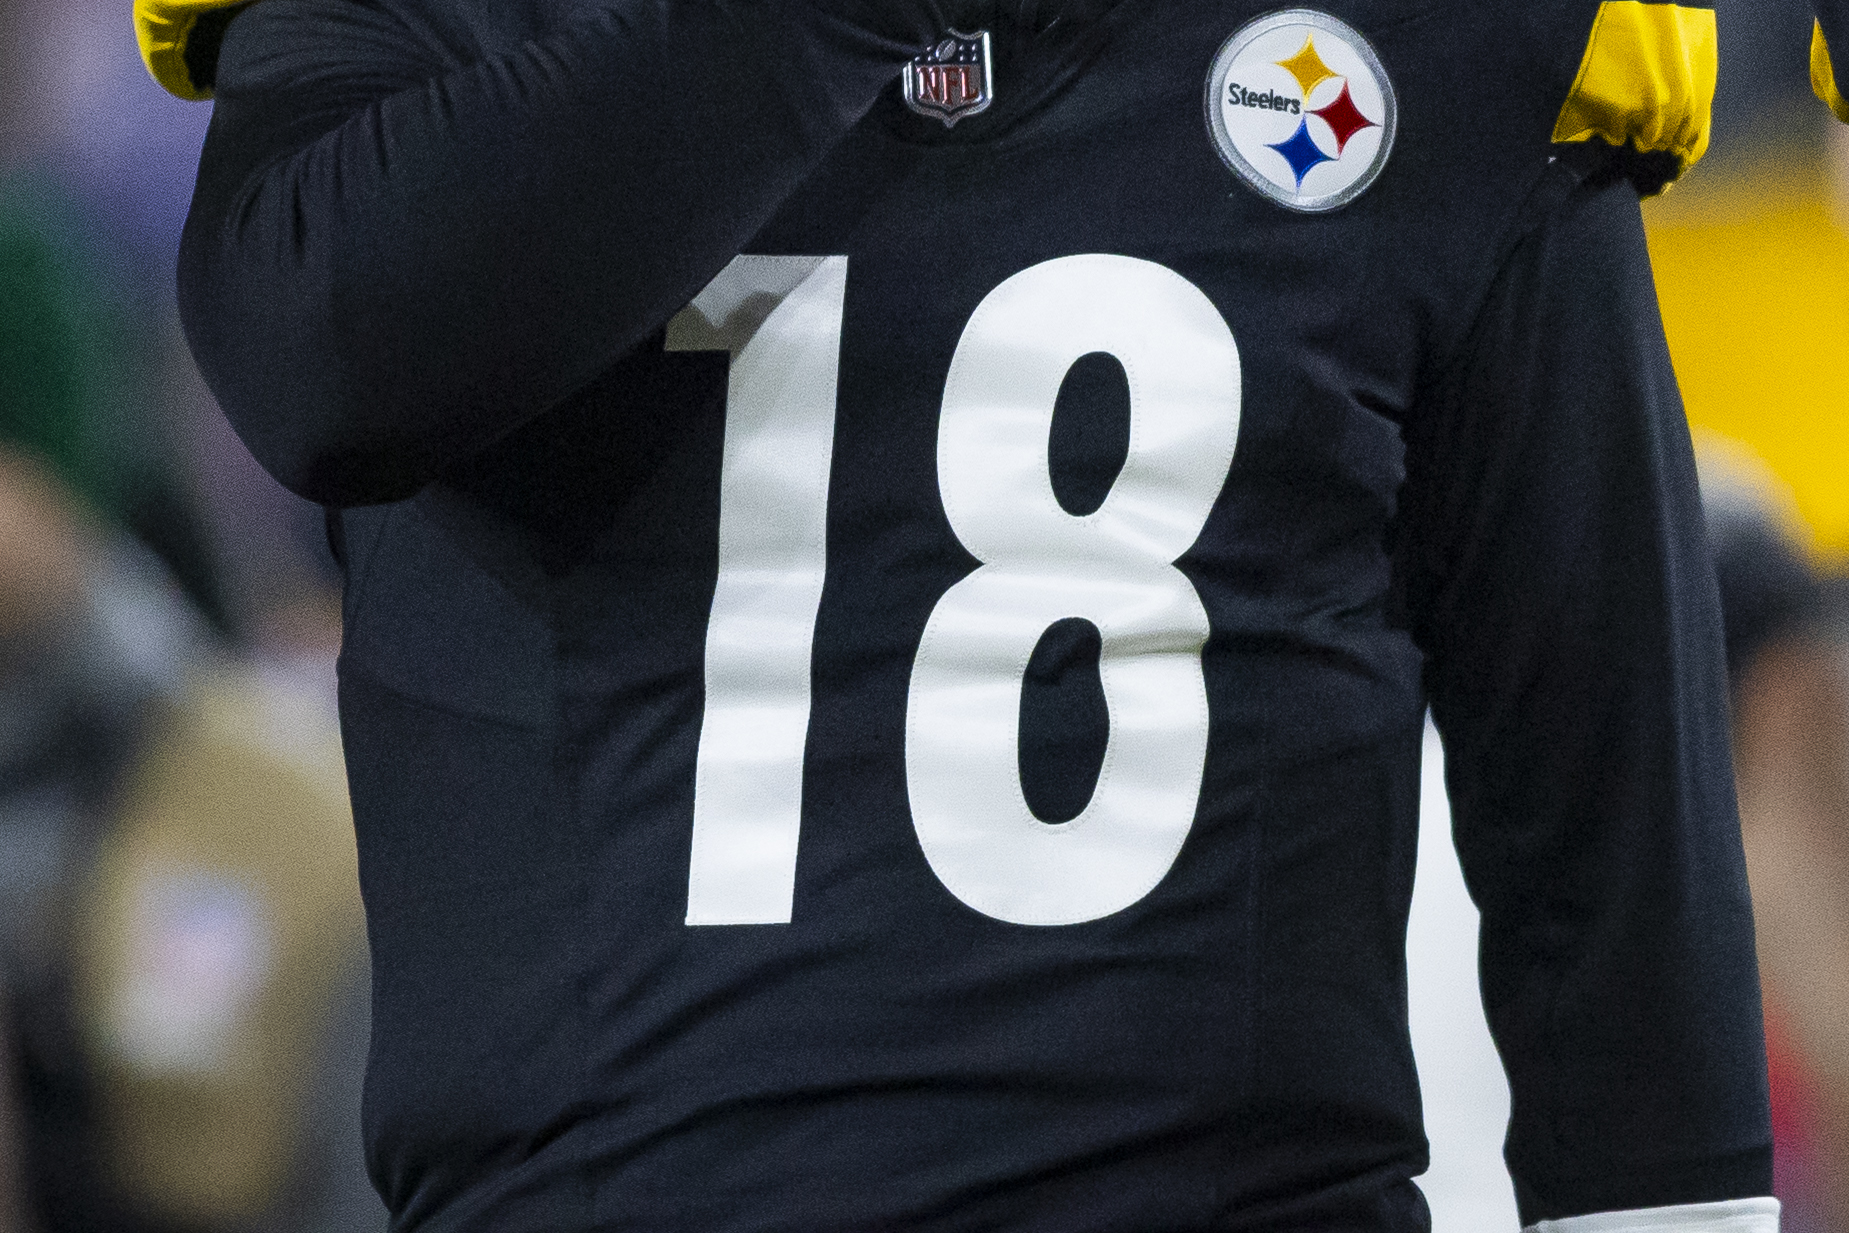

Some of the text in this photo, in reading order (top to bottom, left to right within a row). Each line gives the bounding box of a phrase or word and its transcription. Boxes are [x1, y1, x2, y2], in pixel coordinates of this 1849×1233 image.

[916, 66, 980, 105] NFL
[1227, 82, 1301, 116] Steelers
[665, 253, 1242, 927] 18
